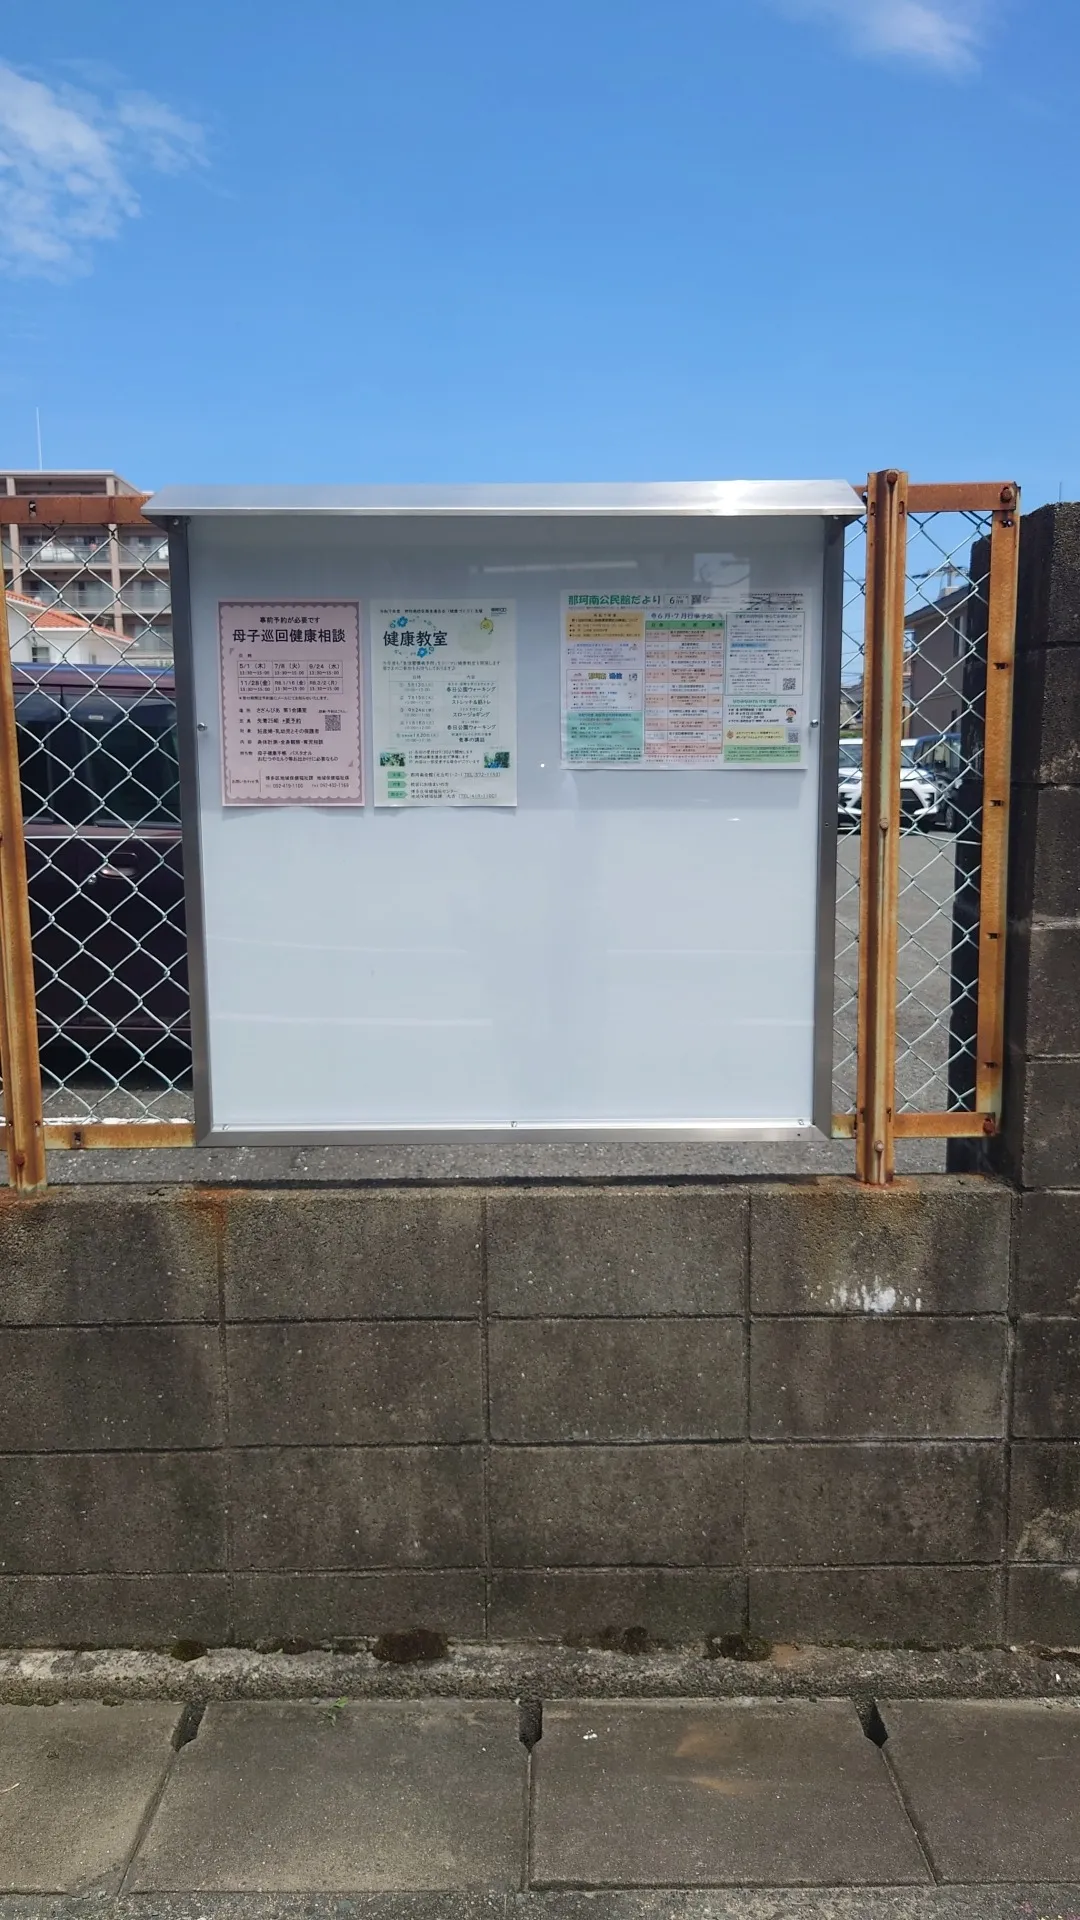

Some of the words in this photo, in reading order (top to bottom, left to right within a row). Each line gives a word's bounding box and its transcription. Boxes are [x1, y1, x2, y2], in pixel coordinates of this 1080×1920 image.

[568, 594, 661, 606] 那珂南公民館だより
[259, 616, 321, 625] 事前予約が必要です
[232, 628, 347, 643] 母子巡回健康相談
[383, 630, 449, 647] 健康教室
